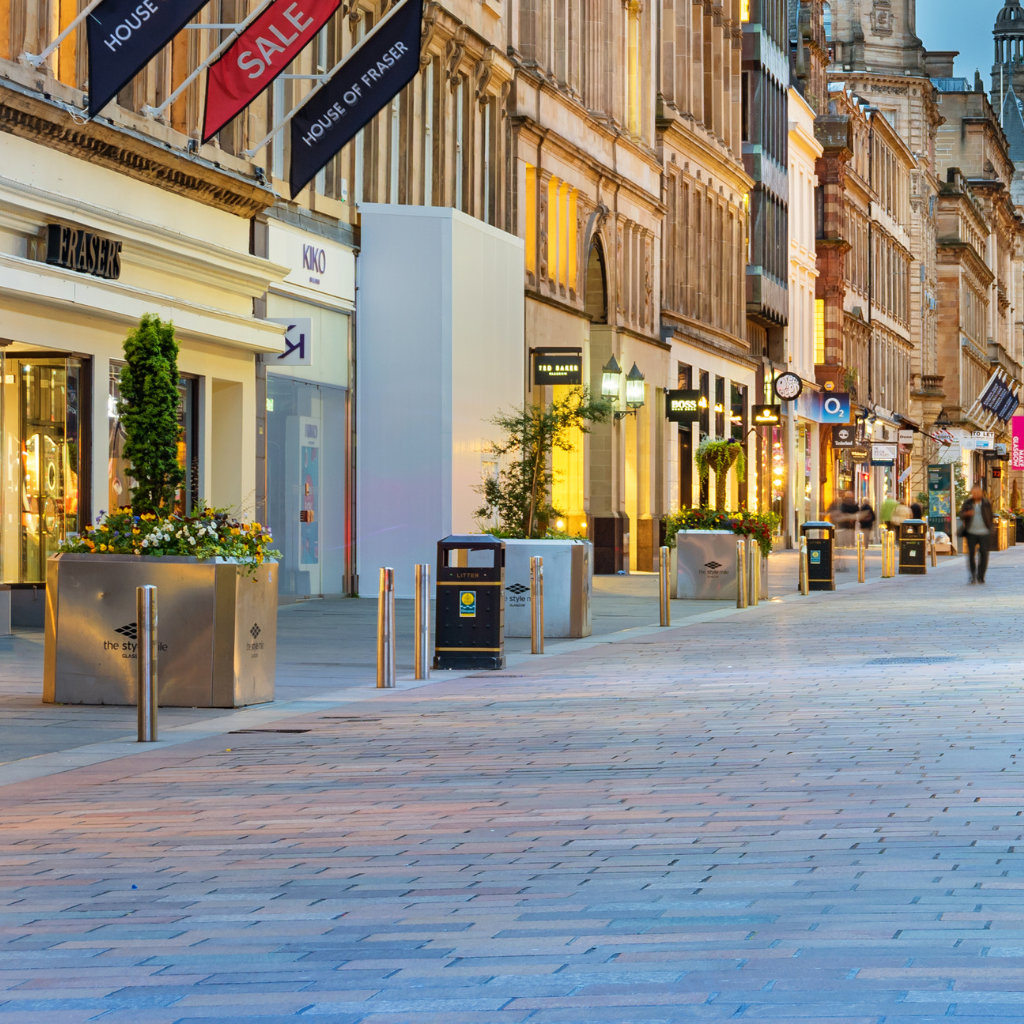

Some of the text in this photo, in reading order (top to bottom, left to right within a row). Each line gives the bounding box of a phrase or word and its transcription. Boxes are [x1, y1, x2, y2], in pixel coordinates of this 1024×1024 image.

[237, 1, 314, 79] SALE
[302, 41, 409, 147] HOUSE OF FRASER
[57, 224, 122, 280] FRASERS
[303, 243, 326, 274] KIKO
[538, 364, 579, 372] TED BAKER
[671, 400, 697, 408] BOSS
[103, 641, 168, 652] the sty ile
